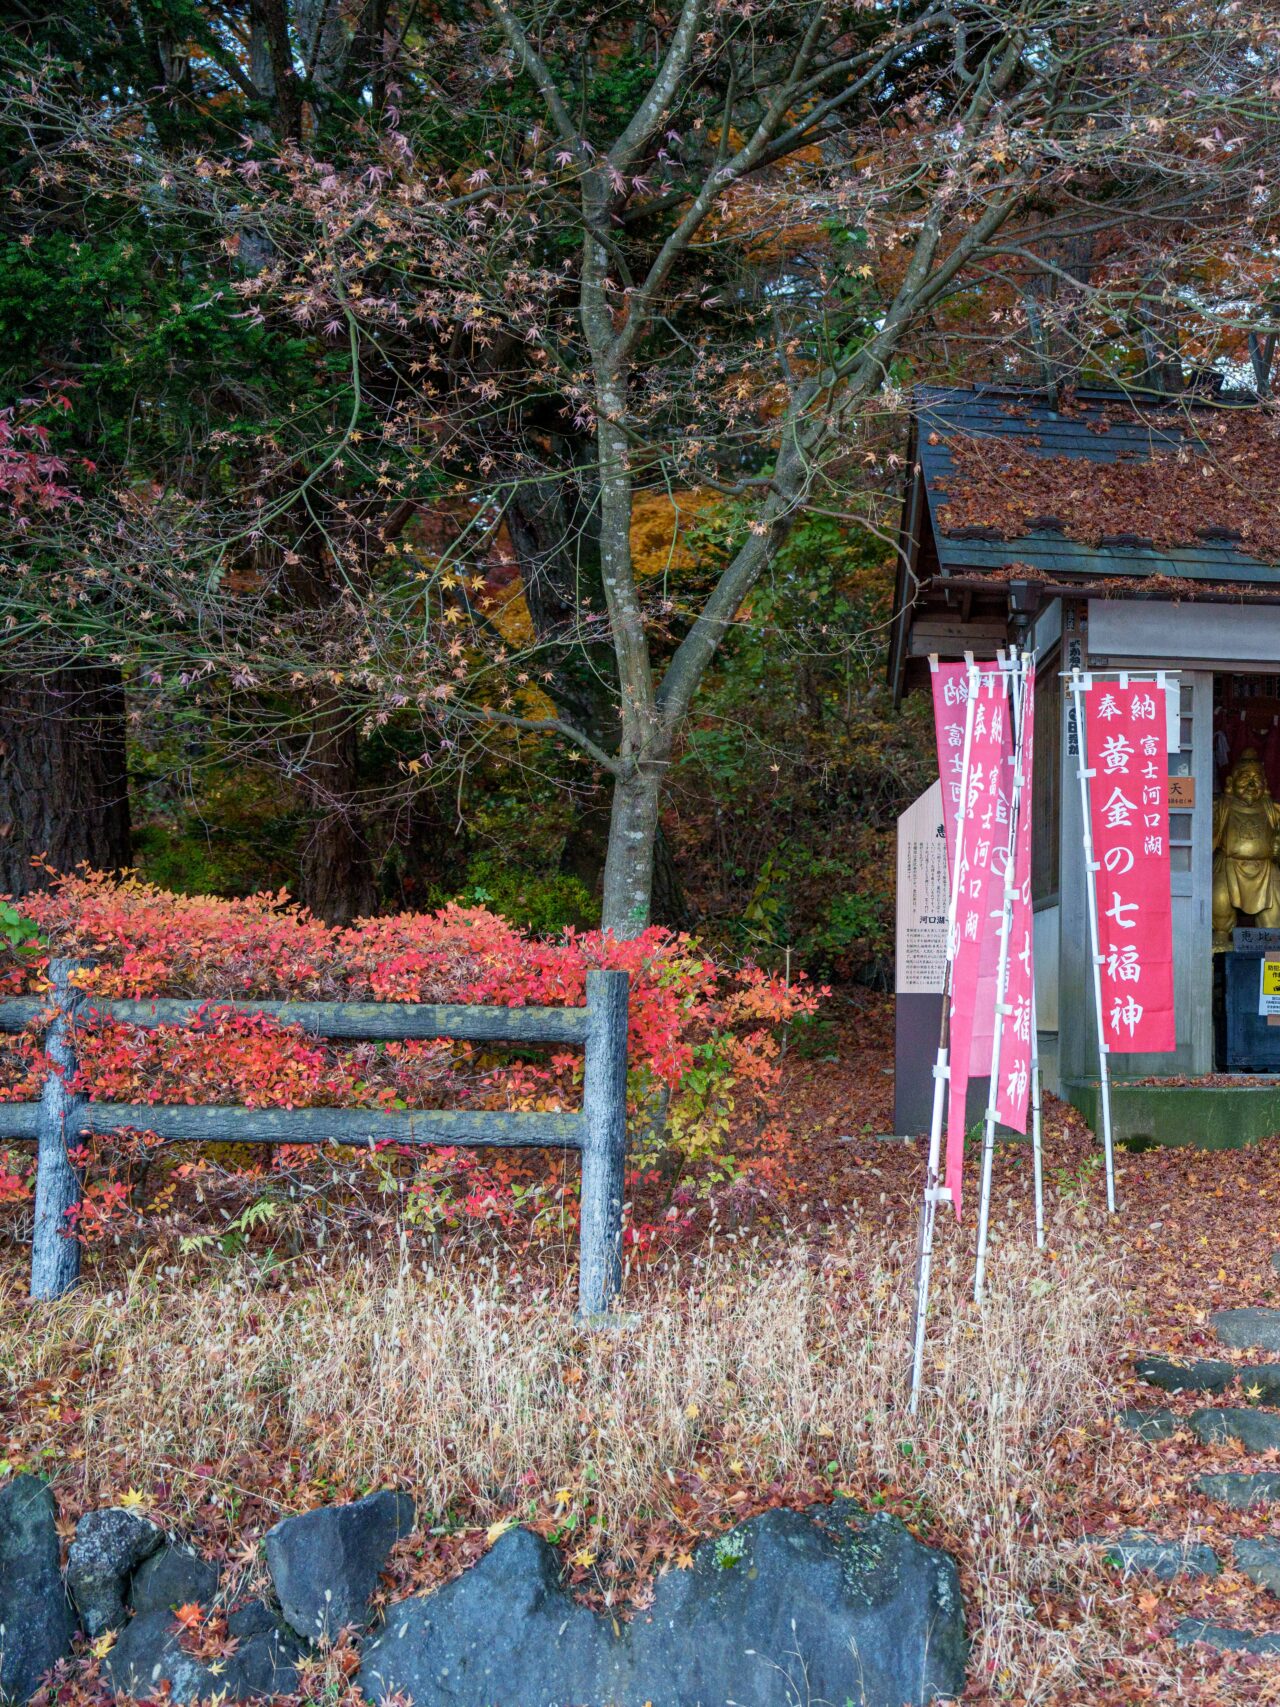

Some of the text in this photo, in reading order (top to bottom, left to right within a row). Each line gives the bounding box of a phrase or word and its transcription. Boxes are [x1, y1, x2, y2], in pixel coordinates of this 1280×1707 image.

[1097, 693, 1156, 721] 奉納
[1140, 735, 1163, 856] 富士河口湖
[1170, 782, 1183, 795] 天
[965, 766, 999, 941] 富士河口湖
[1099, 734, 1144, 1038] 黄金の七福神
